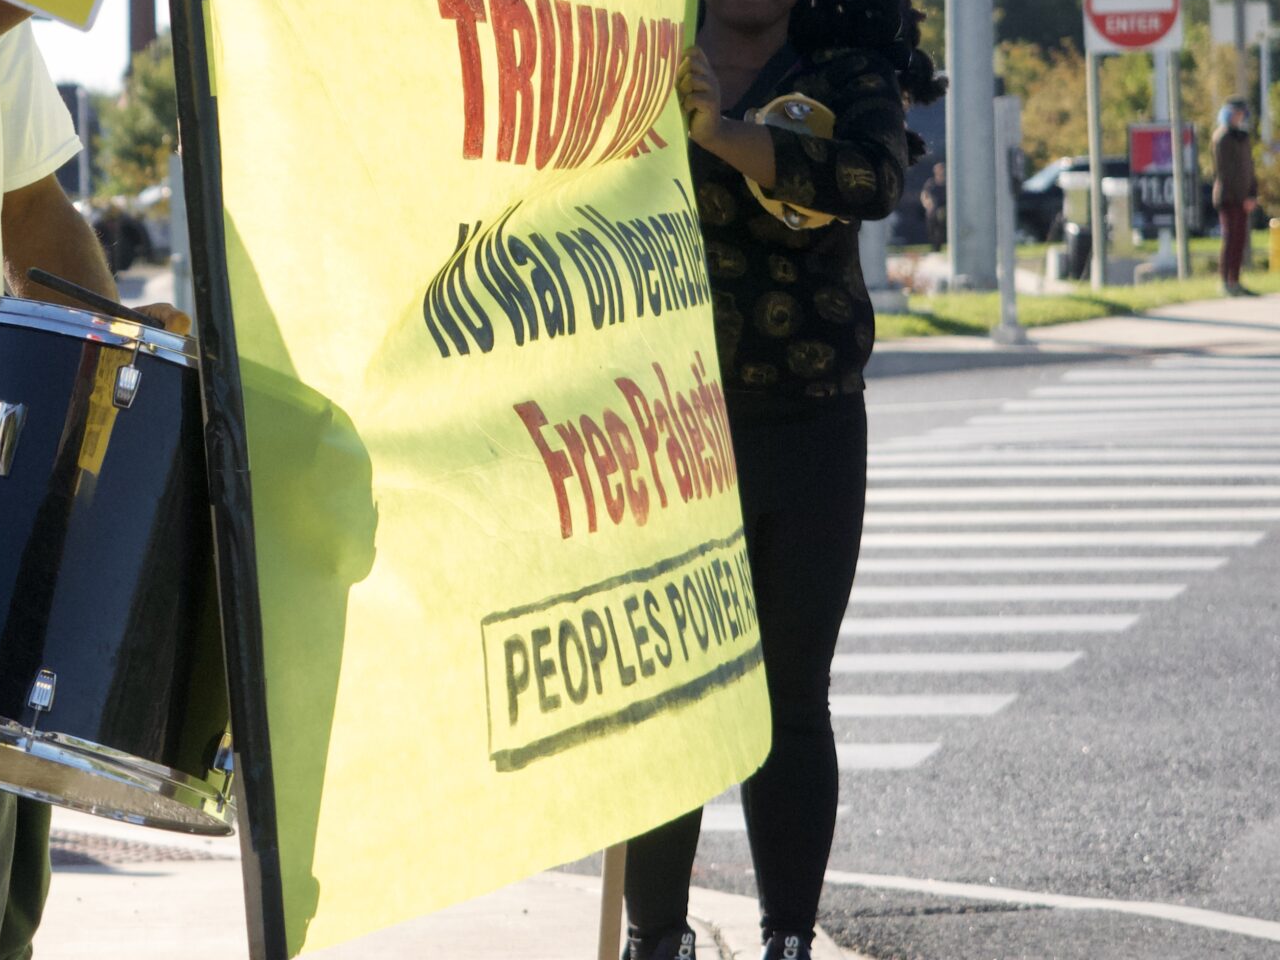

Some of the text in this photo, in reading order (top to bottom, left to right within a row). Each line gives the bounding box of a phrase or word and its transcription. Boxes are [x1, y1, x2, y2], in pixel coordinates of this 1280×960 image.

[1105, 14, 1160, 36] ENTER
[556, 228, 625, 331] on
[514, 400, 650, 539] Free
[503, 589, 673, 727] PEOPLES
[664, 558, 747, 662] POWER
